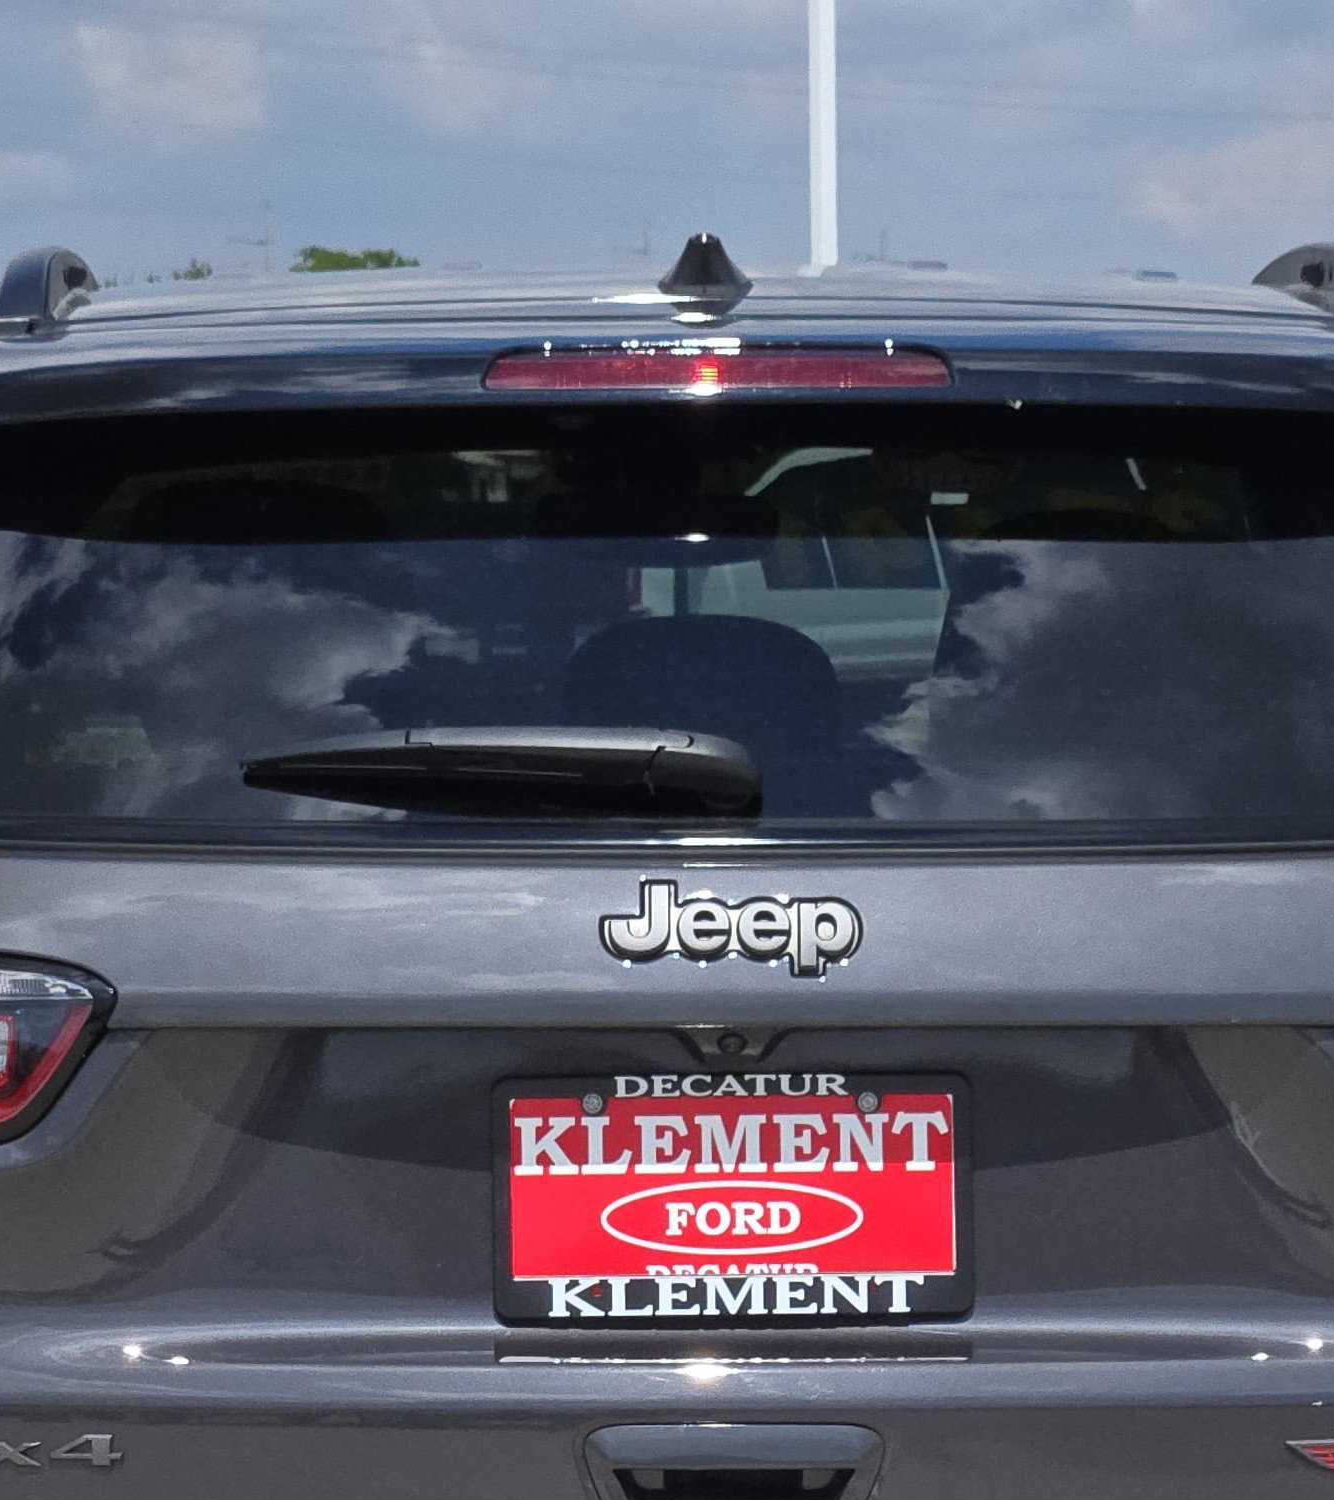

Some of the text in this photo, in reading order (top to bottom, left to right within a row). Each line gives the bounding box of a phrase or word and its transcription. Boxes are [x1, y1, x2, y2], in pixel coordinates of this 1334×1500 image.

[602, 881, 860, 975] Jeep
[613, 1073, 849, 1098] DECATUR
[514, 1111, 949, 1175] KLEMENT
[665, 1201, 801, 1236] FORD
[548, 1275, 924, 1317] KLEMENT
